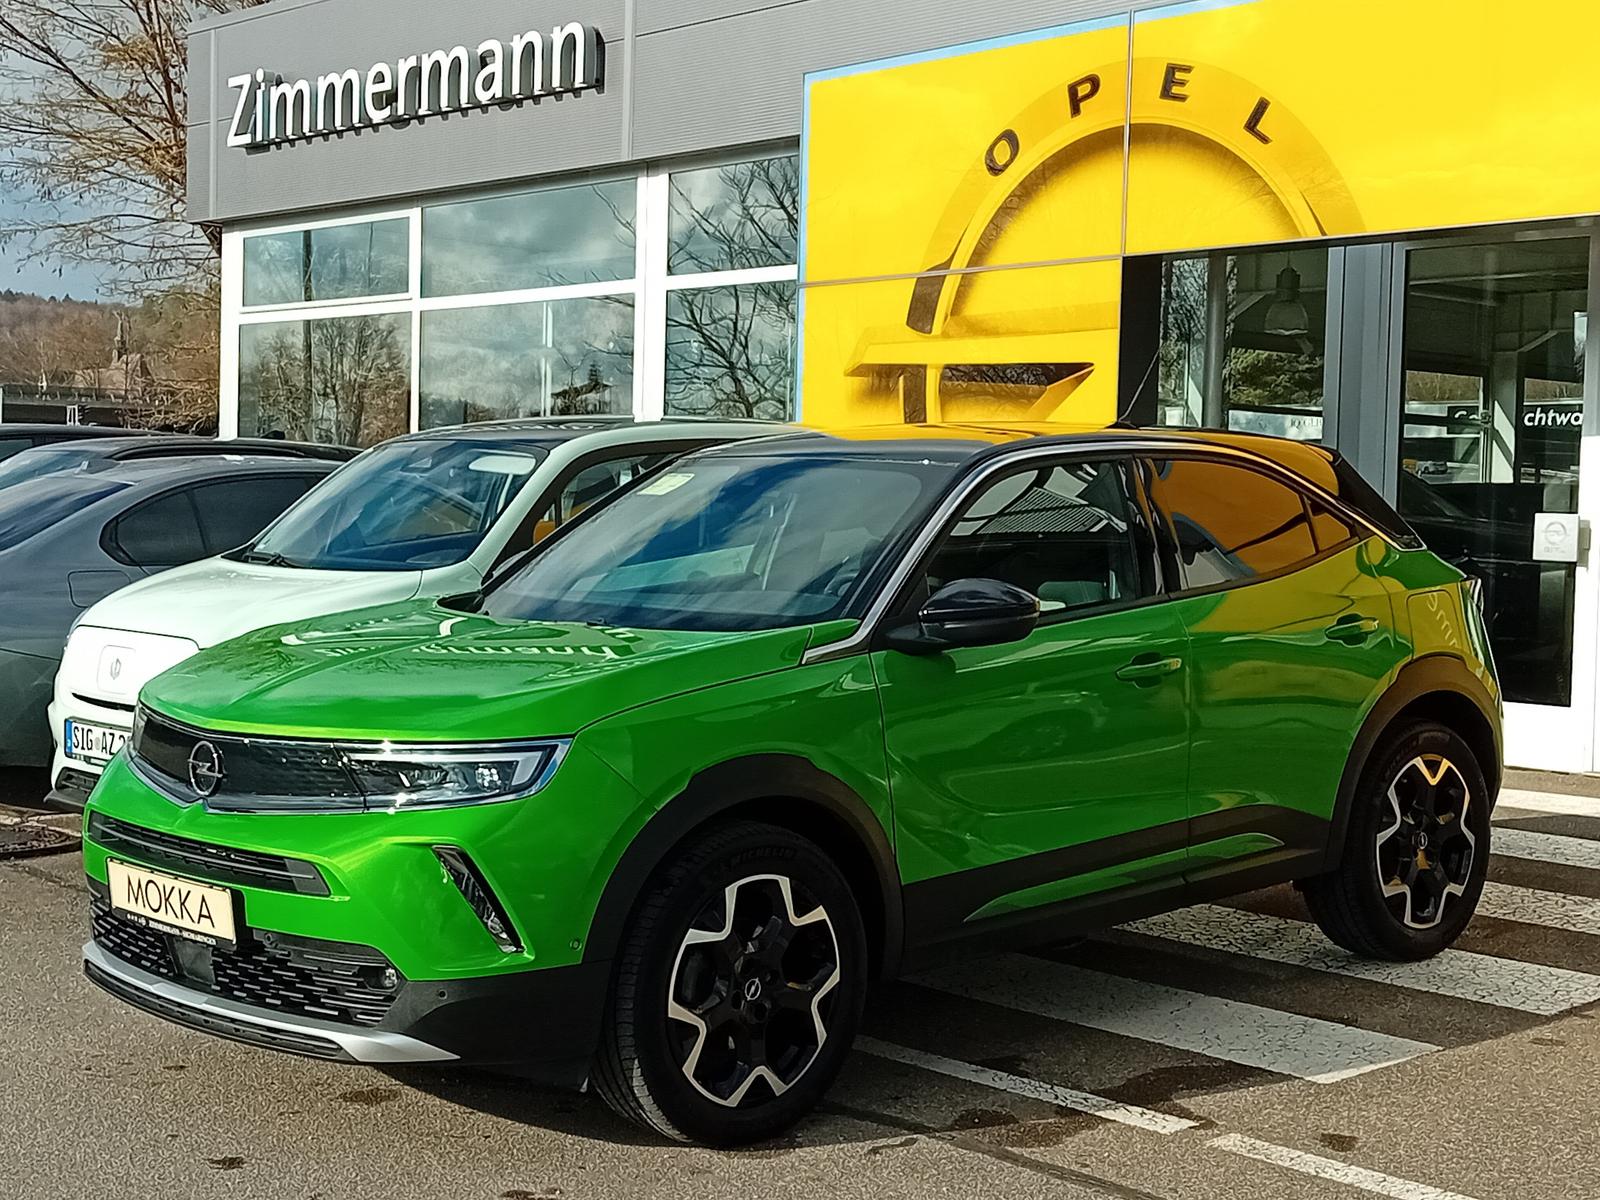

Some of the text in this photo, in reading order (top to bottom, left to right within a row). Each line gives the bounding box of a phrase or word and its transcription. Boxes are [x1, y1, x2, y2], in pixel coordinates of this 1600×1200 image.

[227, 20, 591, 147] Zimmermann
[984, 62, 1273, 178] OPEL
[73, 726, 93, 751] SIG
[101, 731, 116, 756] AZ
[126, 874, 215, 929] MOKKA
